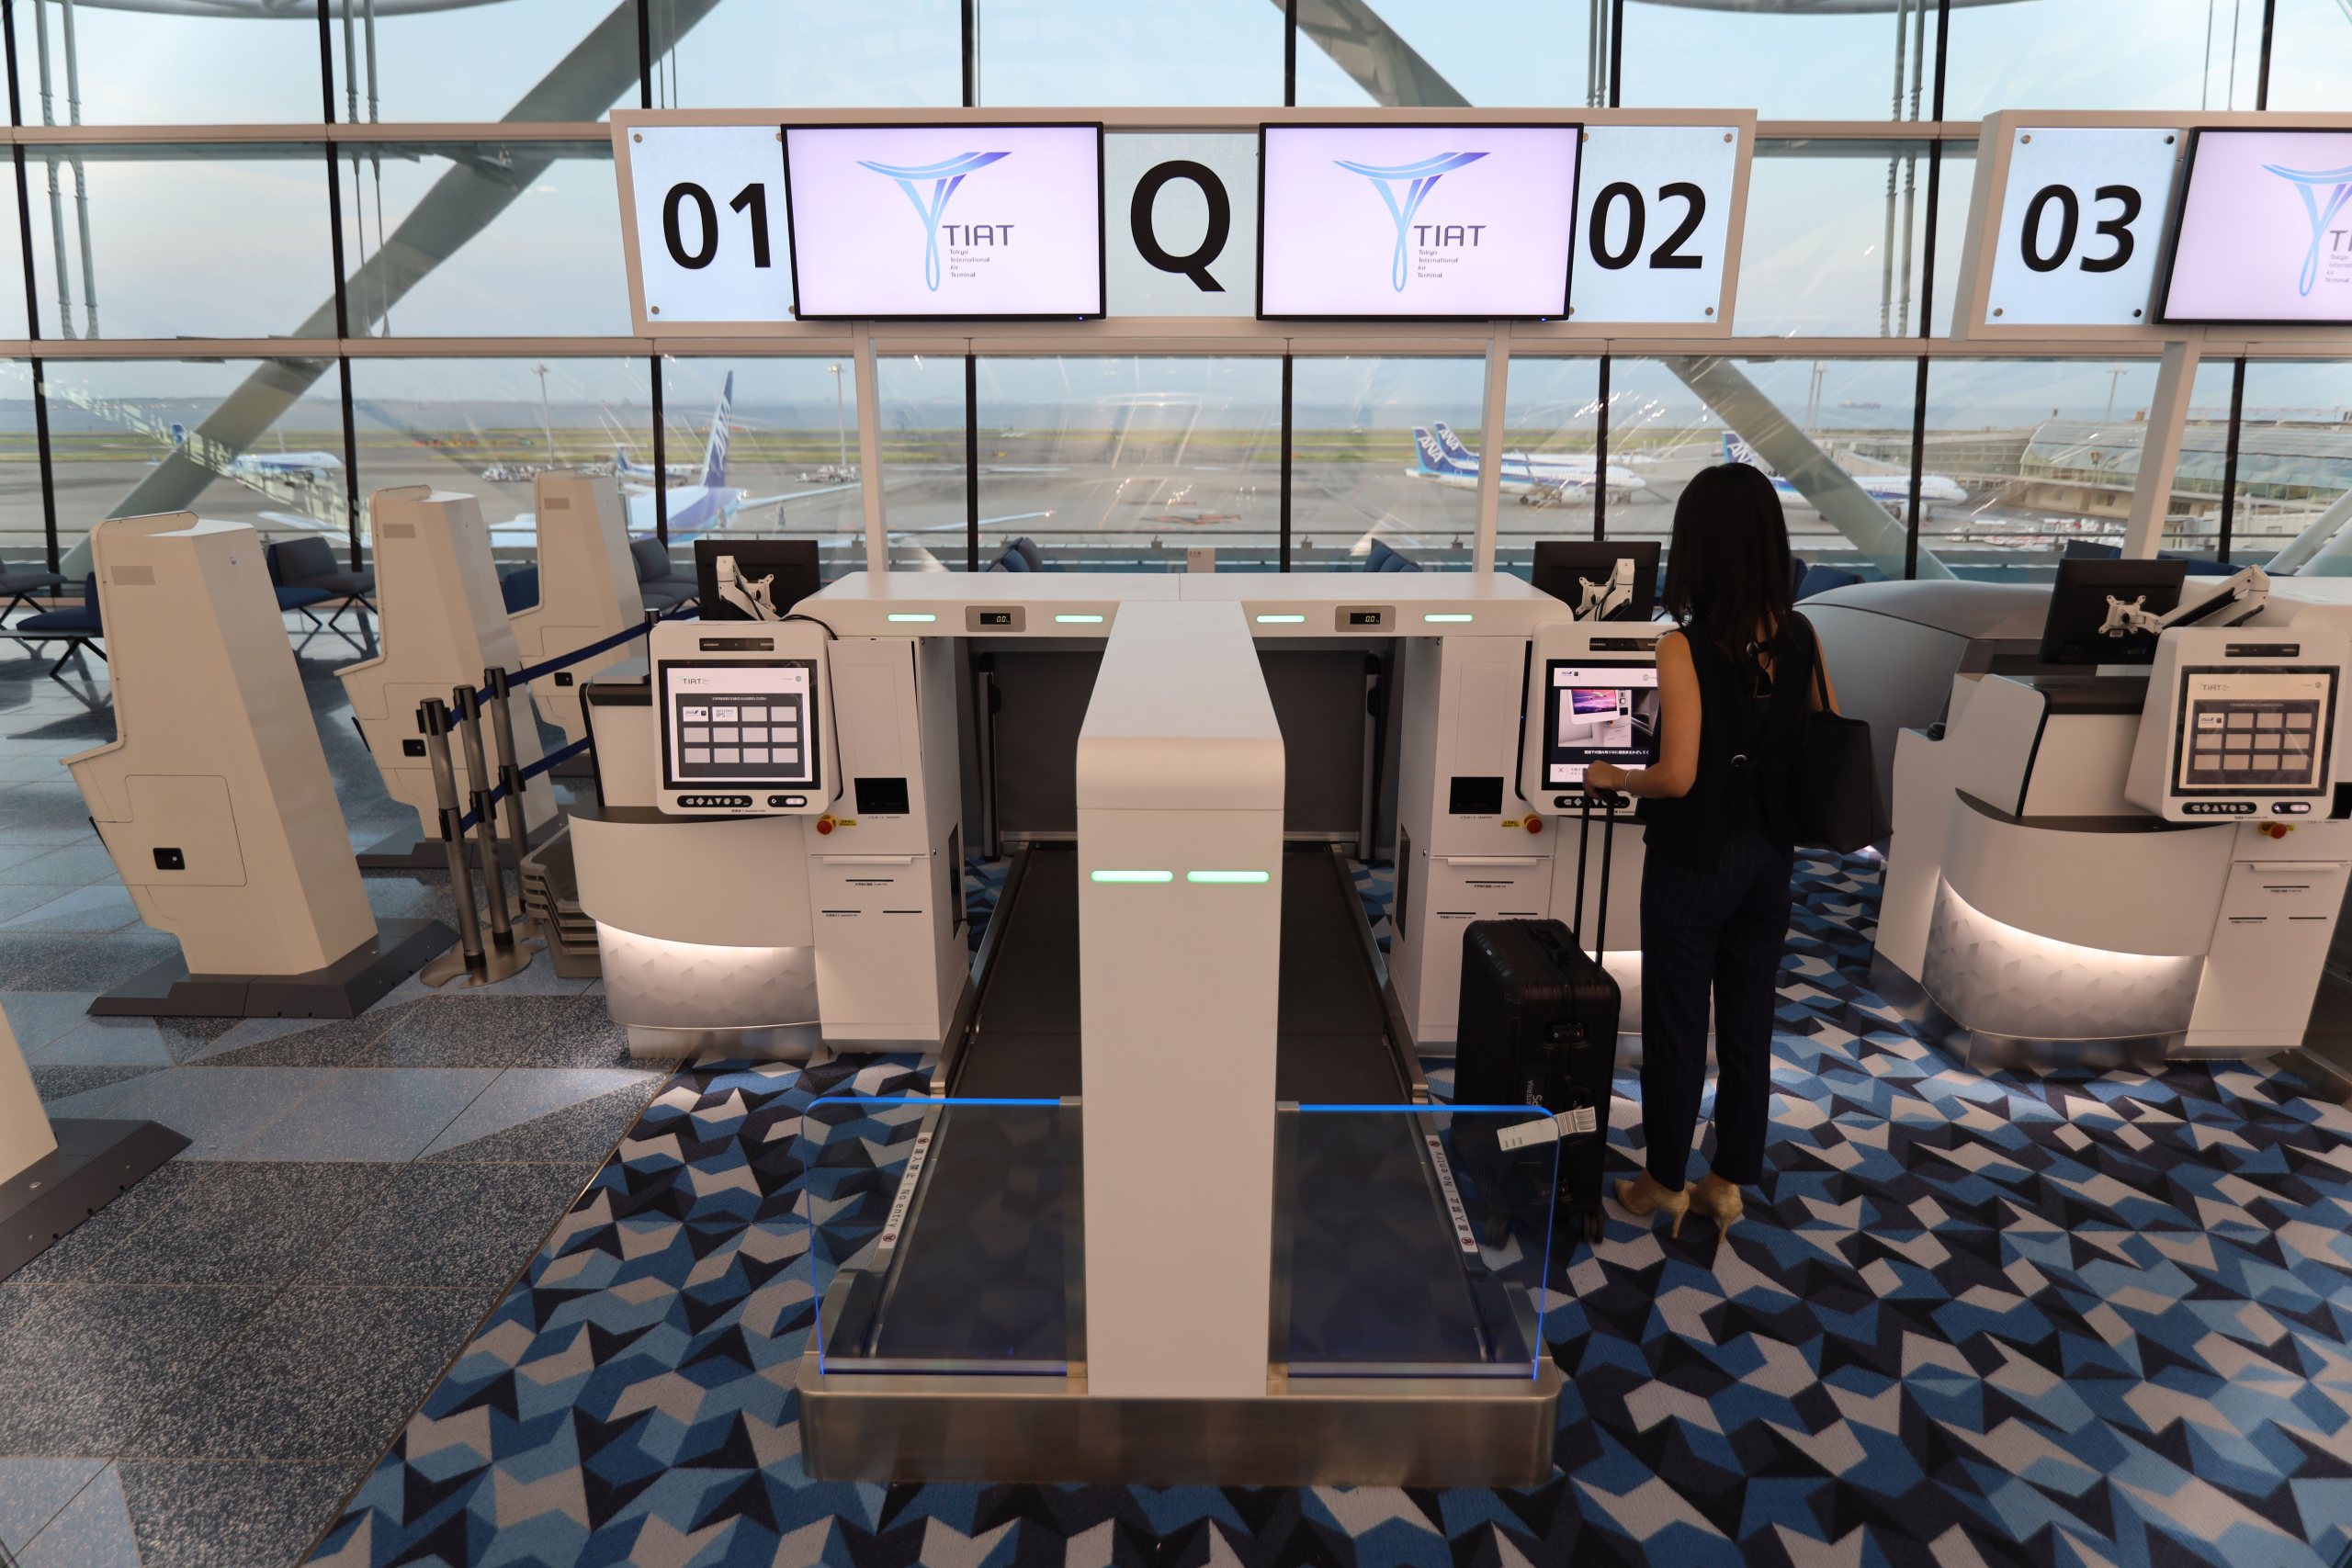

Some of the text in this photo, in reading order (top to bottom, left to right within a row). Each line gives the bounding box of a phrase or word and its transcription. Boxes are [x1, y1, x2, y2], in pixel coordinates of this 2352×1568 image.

[663, 181, 772, 269] 01
[943, 224, 1015, 246] TIAT
[1130, 159, 1231, 292] Q
[1413, 225, 1487, 247] TIAT
[1589, 181, 1707, 270] 02
[2020, 184, 2142, 273] 03
[1417, 436, 1443, 463] ANA
[1439, 429, 1460, 451] ANA
[1726, 442, 1754, 466] AN
[1532, 1094, 1542, 1107] PS
[887, 1148, 924, 1228] 進入禁止 No entry
[1434, 1151, 1469, 1231] 進入禁止 No entry
